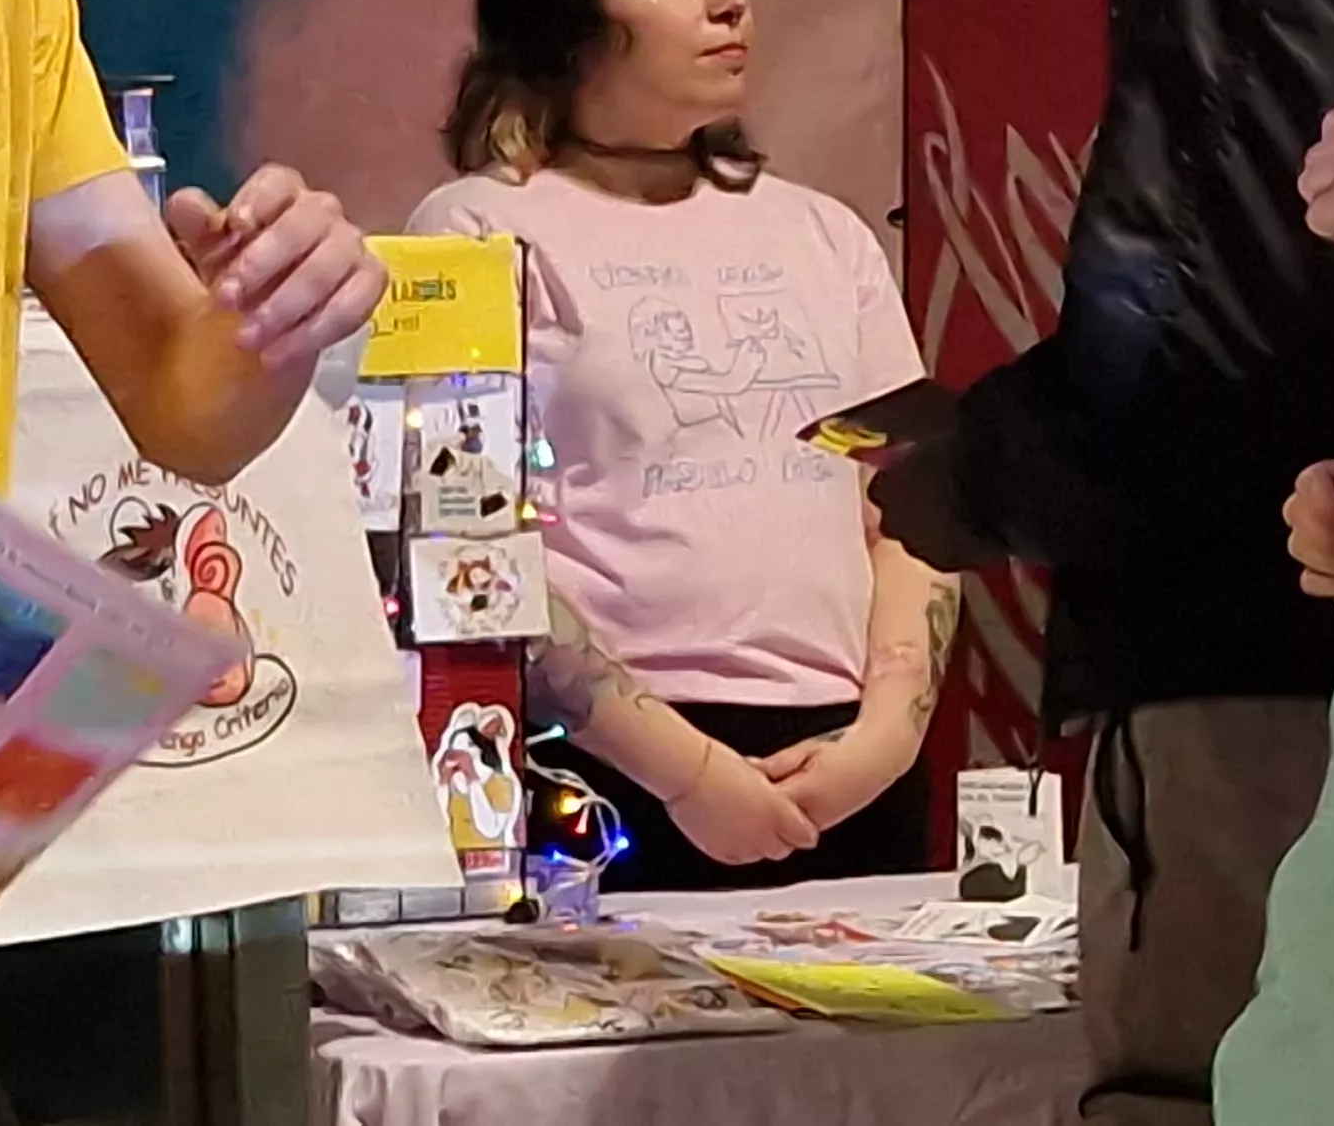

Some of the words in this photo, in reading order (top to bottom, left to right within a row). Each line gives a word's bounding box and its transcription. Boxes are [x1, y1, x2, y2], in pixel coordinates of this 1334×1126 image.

[68, 473, 106, 525] NO
[117, 460, 152, 491] ME
[163, 470, 298, 598] UNTES
[213, 677, 291, 741] Criterio
